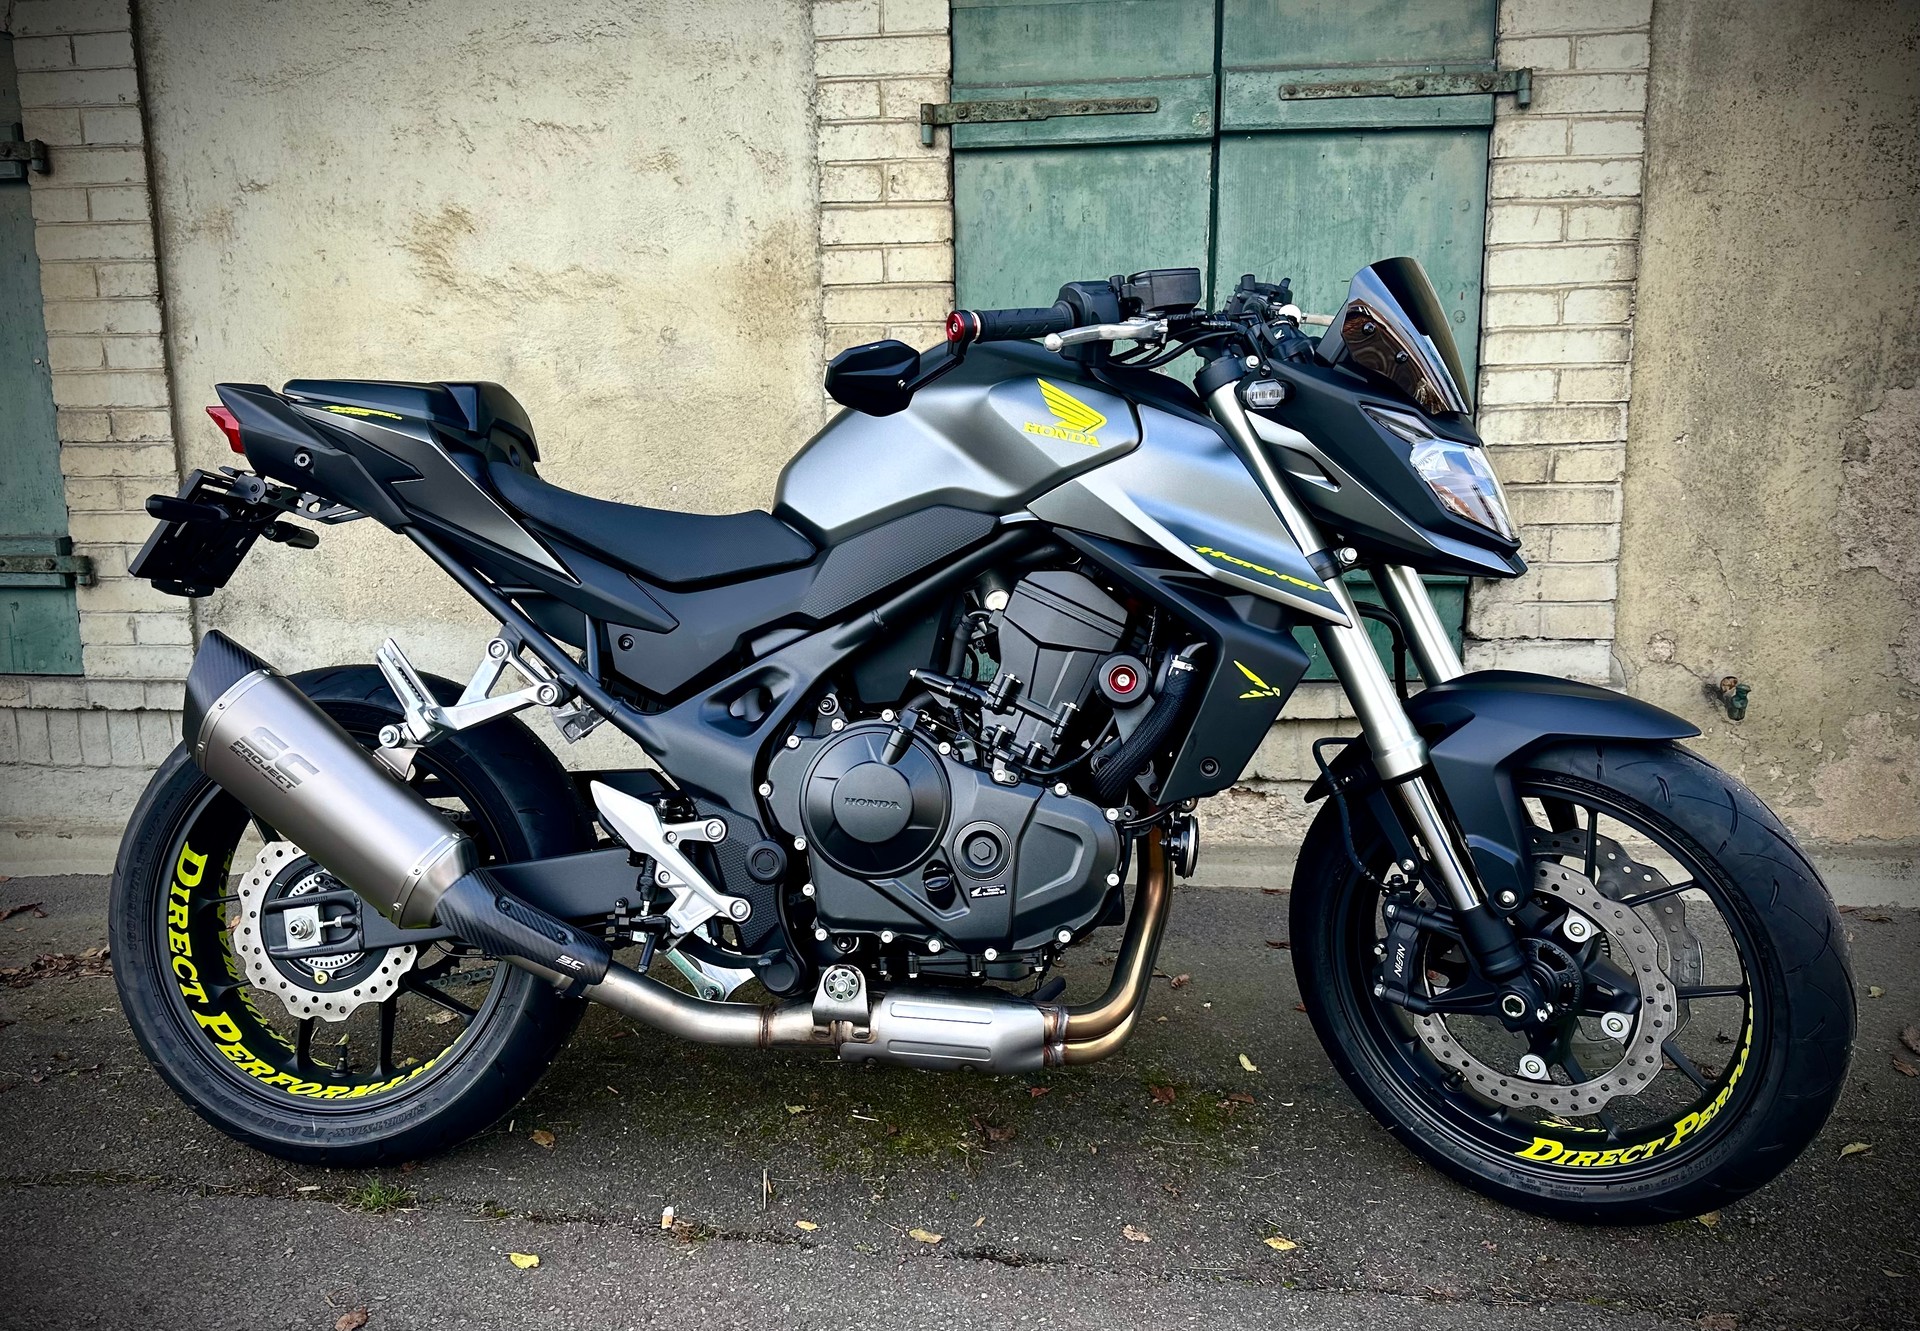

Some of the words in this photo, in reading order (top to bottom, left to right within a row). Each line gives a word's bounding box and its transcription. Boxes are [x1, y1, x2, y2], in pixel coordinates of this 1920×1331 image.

[1023, 421, 1101, 448] HONDA
[232, 740, 297, 790] PROJECT
[239, 726, 321, 786] SC
[844, 797, 902, 810] HONDA
[168, 841, 209, 1004] DIRECT
[1393, 942, 1406, 978] NISSIN
[1514, 1136, 1666, 1167] DIRECT
